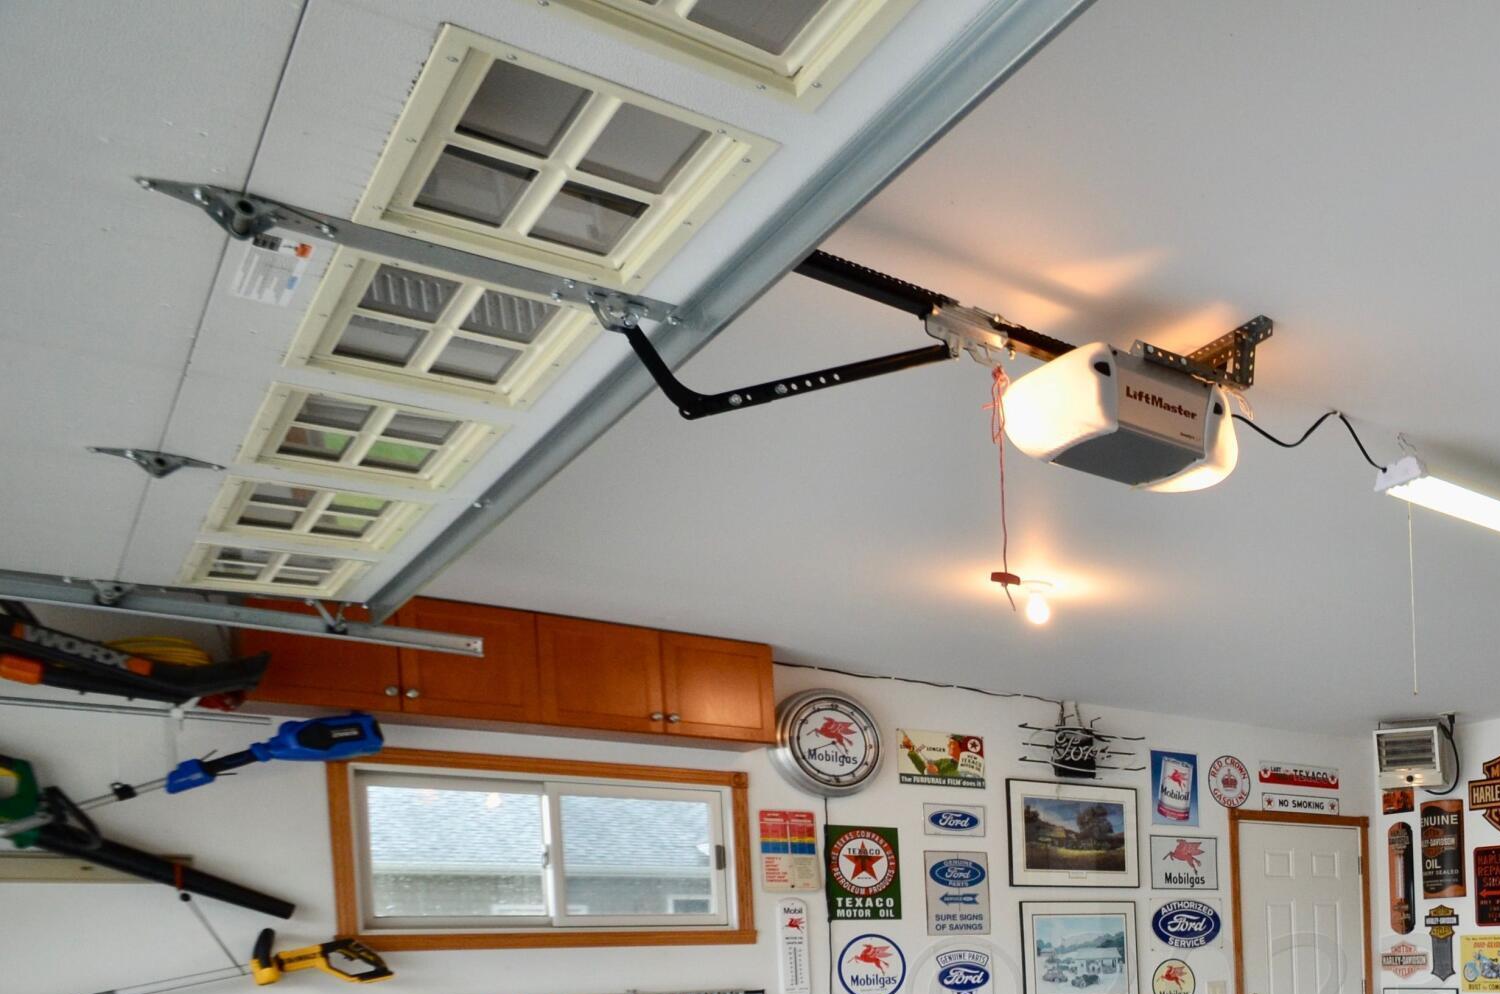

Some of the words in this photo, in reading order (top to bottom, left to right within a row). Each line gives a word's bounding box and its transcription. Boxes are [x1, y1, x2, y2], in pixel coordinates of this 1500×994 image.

[1125, 386, 1197, 420] LiftMaster
[23, 625, 130, 668] WORX
[807, 748, 858, 767] Mobilgas
[1211, 760, 1223, 778] RED
[1224, 757, 1248, 780] CROWN
[1293, 769, 1328, 780] TEXACO
[1161, 785, 1190, 801] Mobiloil
[1213, 789, 1248, 808] GASOLINE
[1279, 799, 1289, 807] NO
[1292, 800, 1324, 810] SMOKING
[938, 812, 969, 828] Ford
[834, 831, 854, 852] TEXAS
[855, 830, 888, 848] COMPANY
[847, 847, 881, 856] TEXACO
[945, 867, 971, 878] Ford
[1425, 859, 1442, 870] OIL
[833, 867, 865, 895] PETROLEUM
[869, 868, 895, 895] PRODUCTS
[1165, 872, 1205, 889] Mobilgas
[836, 897, 895, 908] TEXACO
[1160, 900, 1214, 917] AUTHORIZED
[836, 909, 871, 918] MOTOR
[879, 909, 895, 918] OIL
[1167, 914, 1206, 932] Ford
[1168, 936, 1206, 948] SERVICE
[939, 953, 966, 965] GENUINE
[968, 953, 986, 967] PARTS
[851, 974, 897, 988] Mobilgas
[943, 967, 985, 985] Ford
